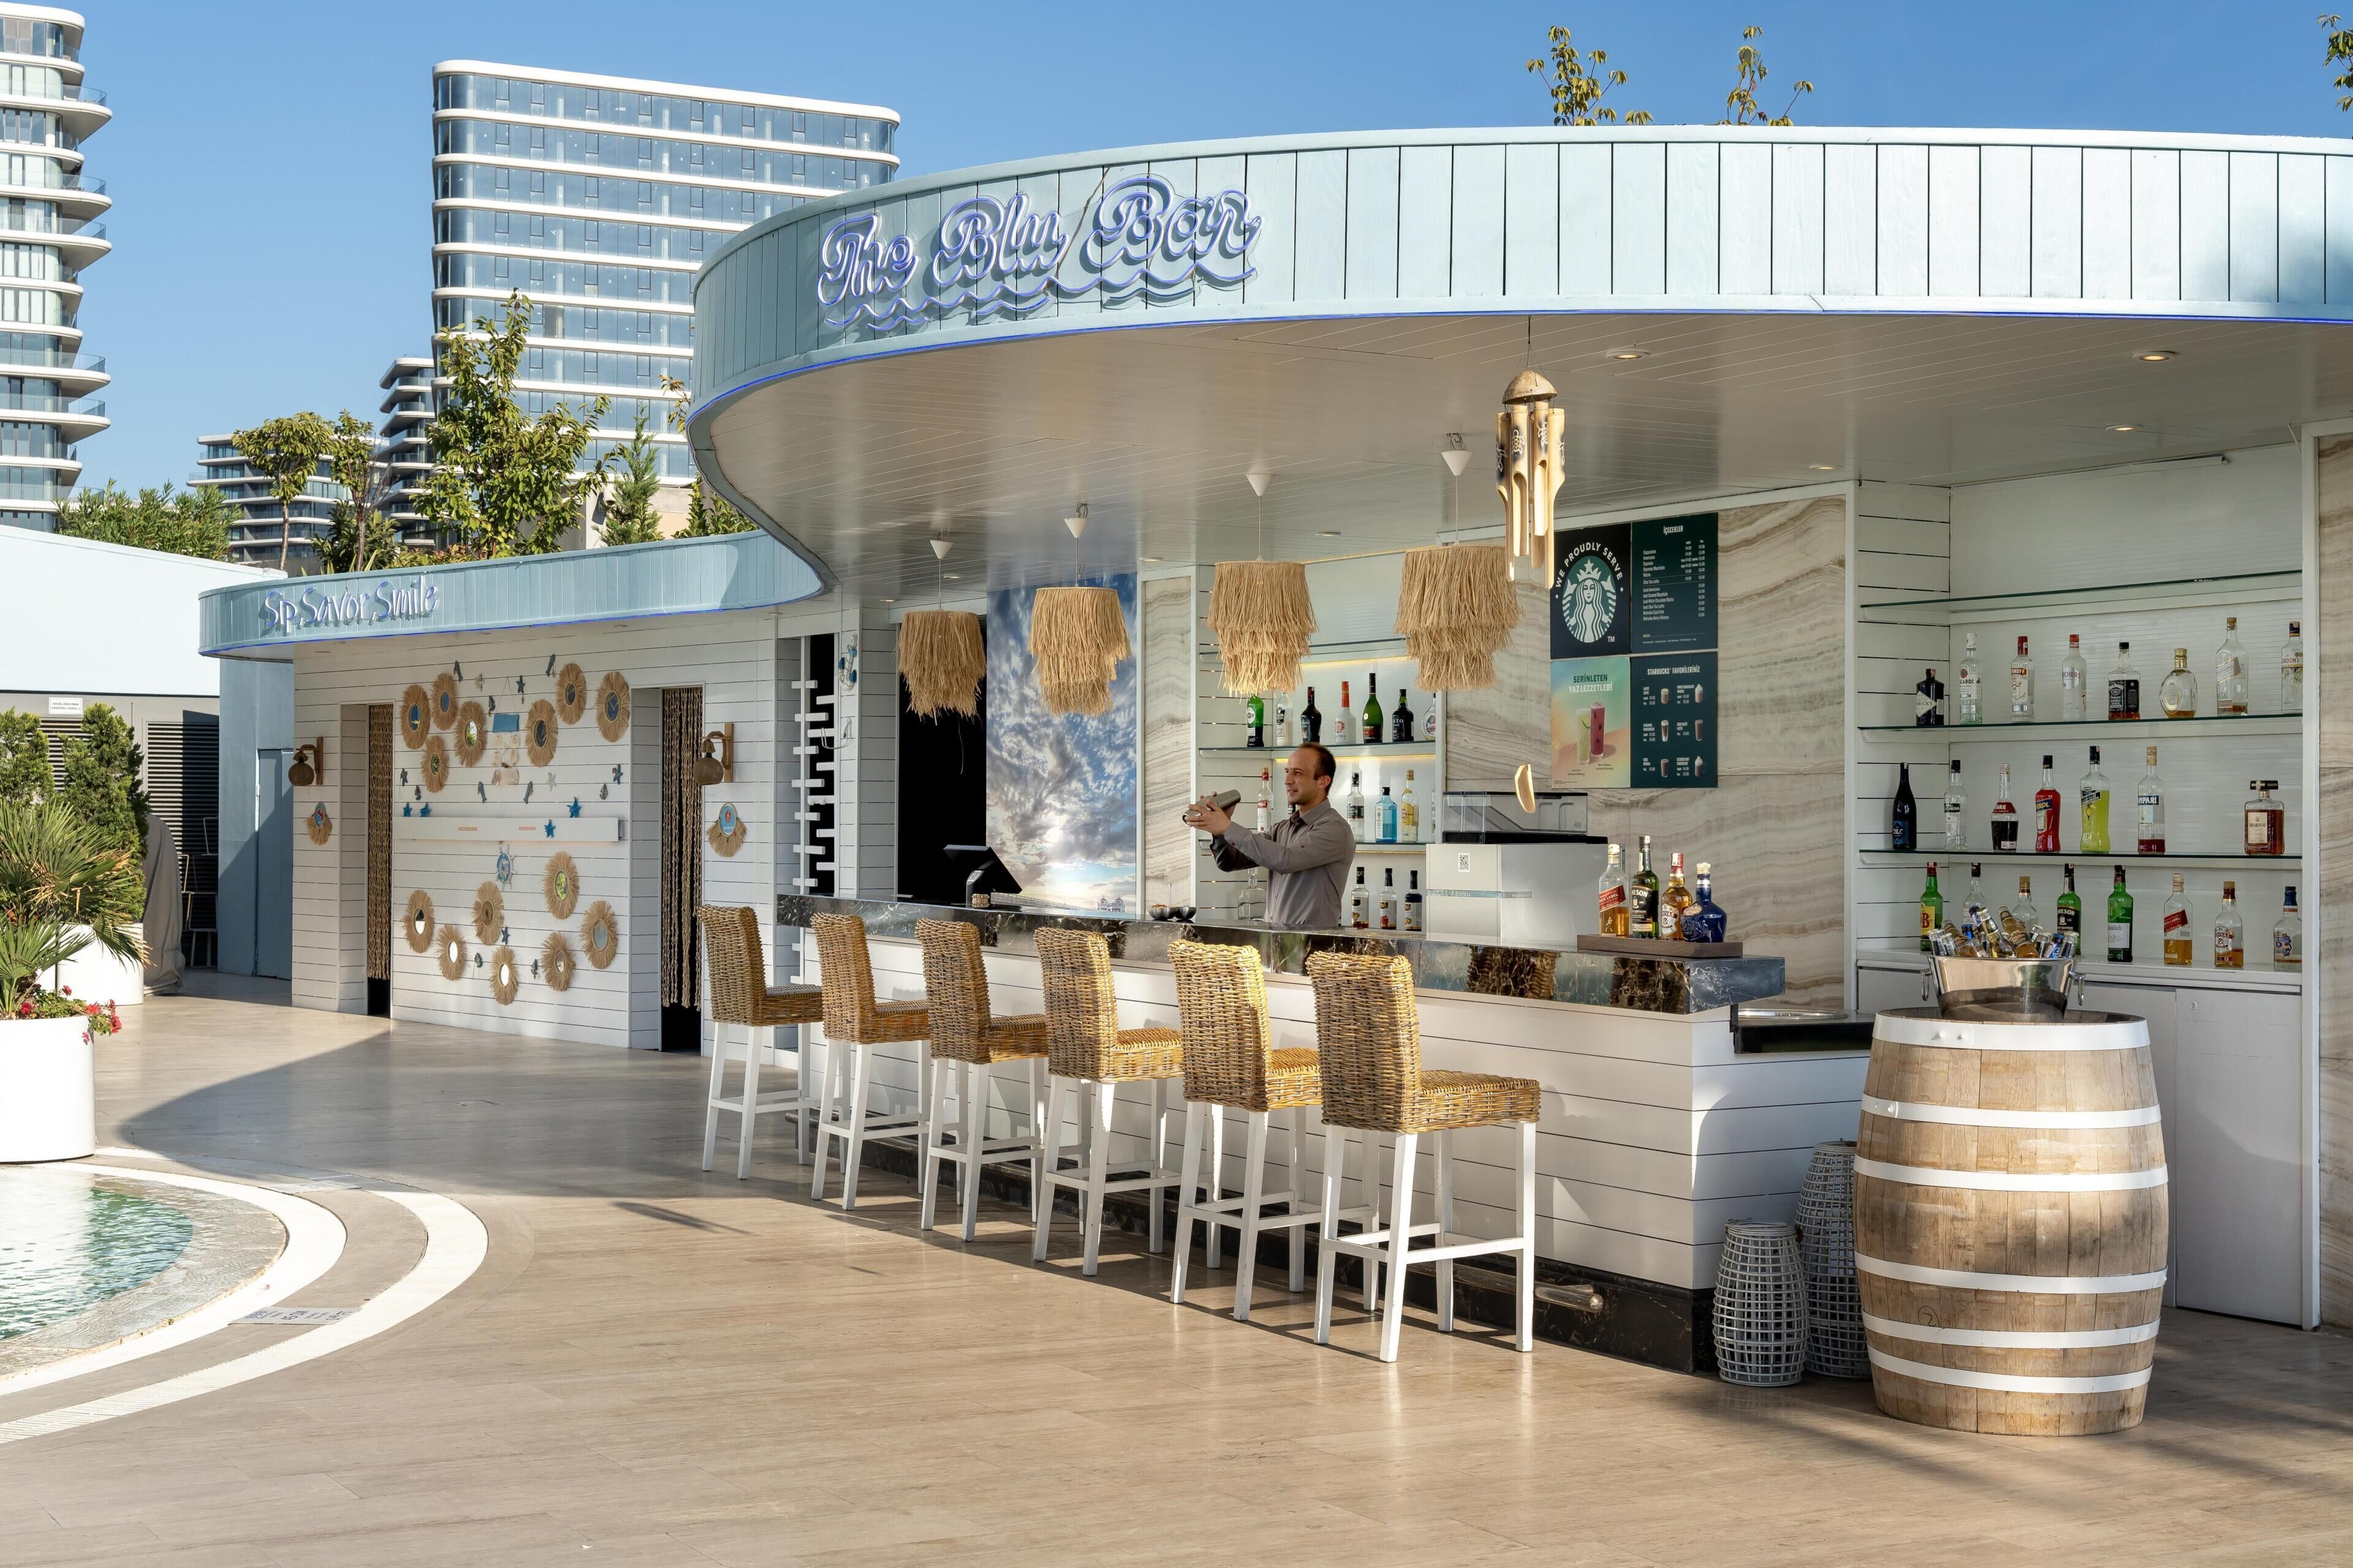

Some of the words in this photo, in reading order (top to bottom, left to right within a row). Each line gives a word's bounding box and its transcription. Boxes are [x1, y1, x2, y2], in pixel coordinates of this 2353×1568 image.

[817, 214, 919, 305] The
[932, 192, 1068, 286] Blu
[1086, 178, 1262, 267] Bar
[1664, 526, 1683, 535] İÇECEKLER
[1556, 569, 1565, 588] WE
[1564, 542, 1601, 567] PROUDLY
[1603, 547, 1623, 580] SERVE
[376, 574, 439, 618] Smile
[1672, 665, 1700, 673] FAVORİLERİNİZ
[1574, 673, 1607, 683] SERİNLETEN
[1580, 682, 1613, 692] LEZZETLERİ
